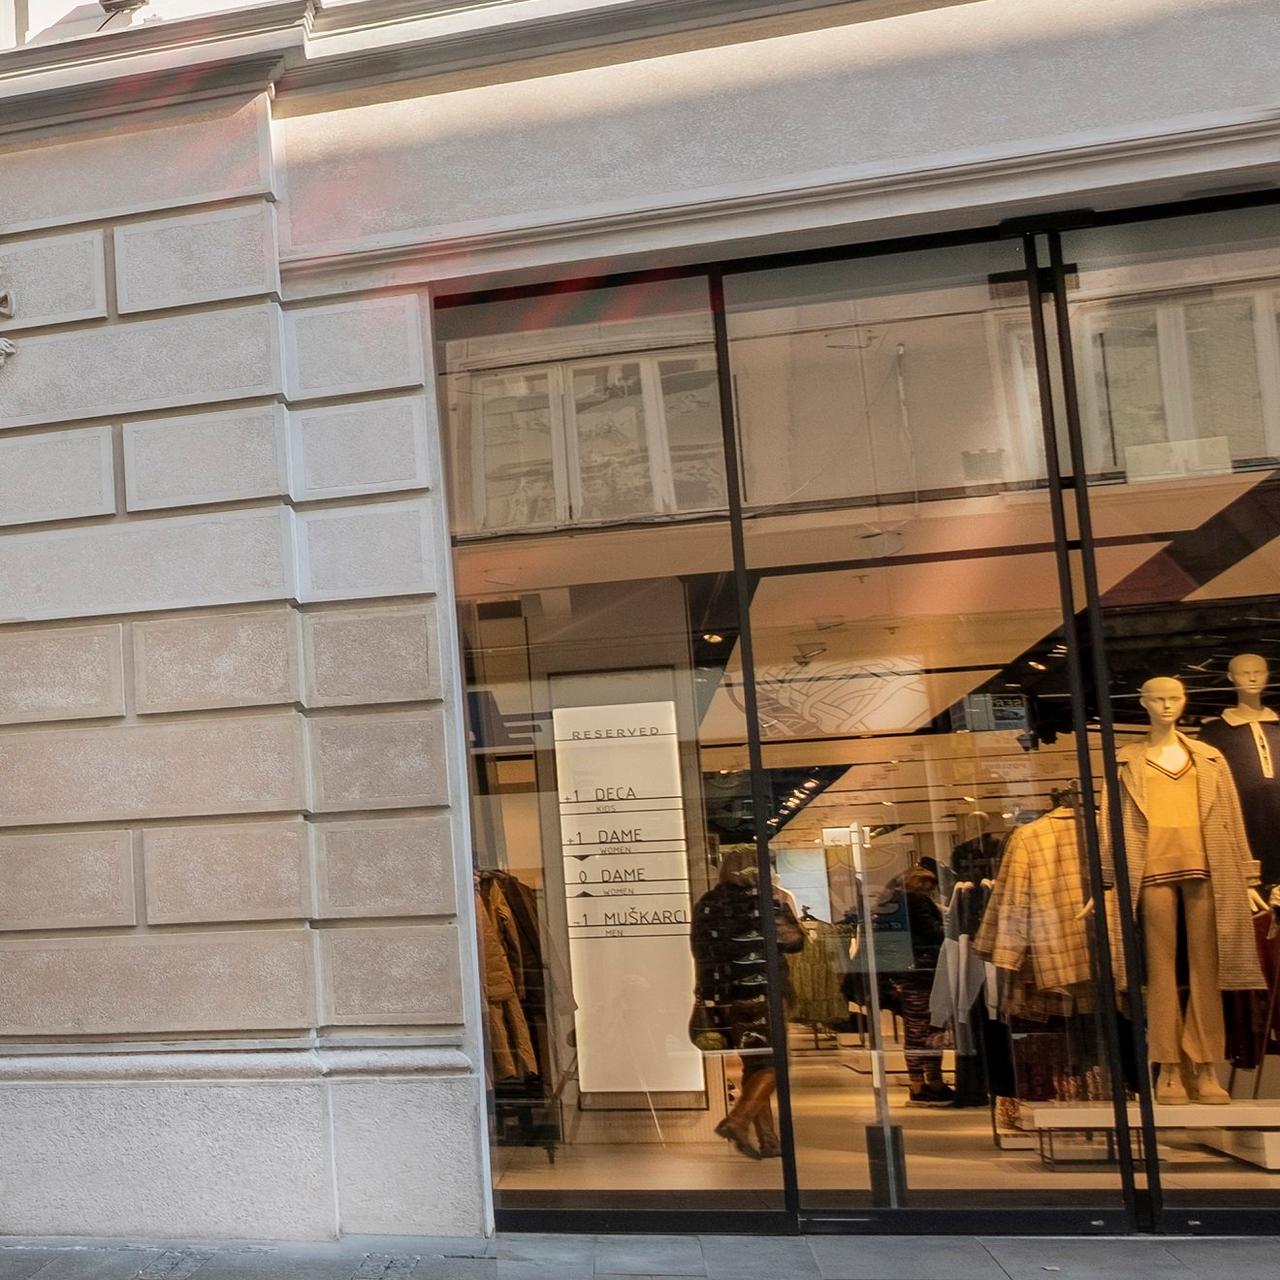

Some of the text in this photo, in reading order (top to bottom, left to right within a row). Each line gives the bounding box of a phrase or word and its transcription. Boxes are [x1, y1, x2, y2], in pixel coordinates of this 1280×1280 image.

[571, 726, 659, 741] RESERVED
[595, 787, 637, 801] DECA
[595, 805, 617, 814] KIDS
[598, 828, 643, 843] DAME
[600, 846, 632, 855] WOMEN
[579, 868, 646, 883] 0 DAME
[603, 887, 635, 896] WOMEN
[604, 906, 688, 926] MUŠKARCI
[605, 928, 624, 937] MEN
